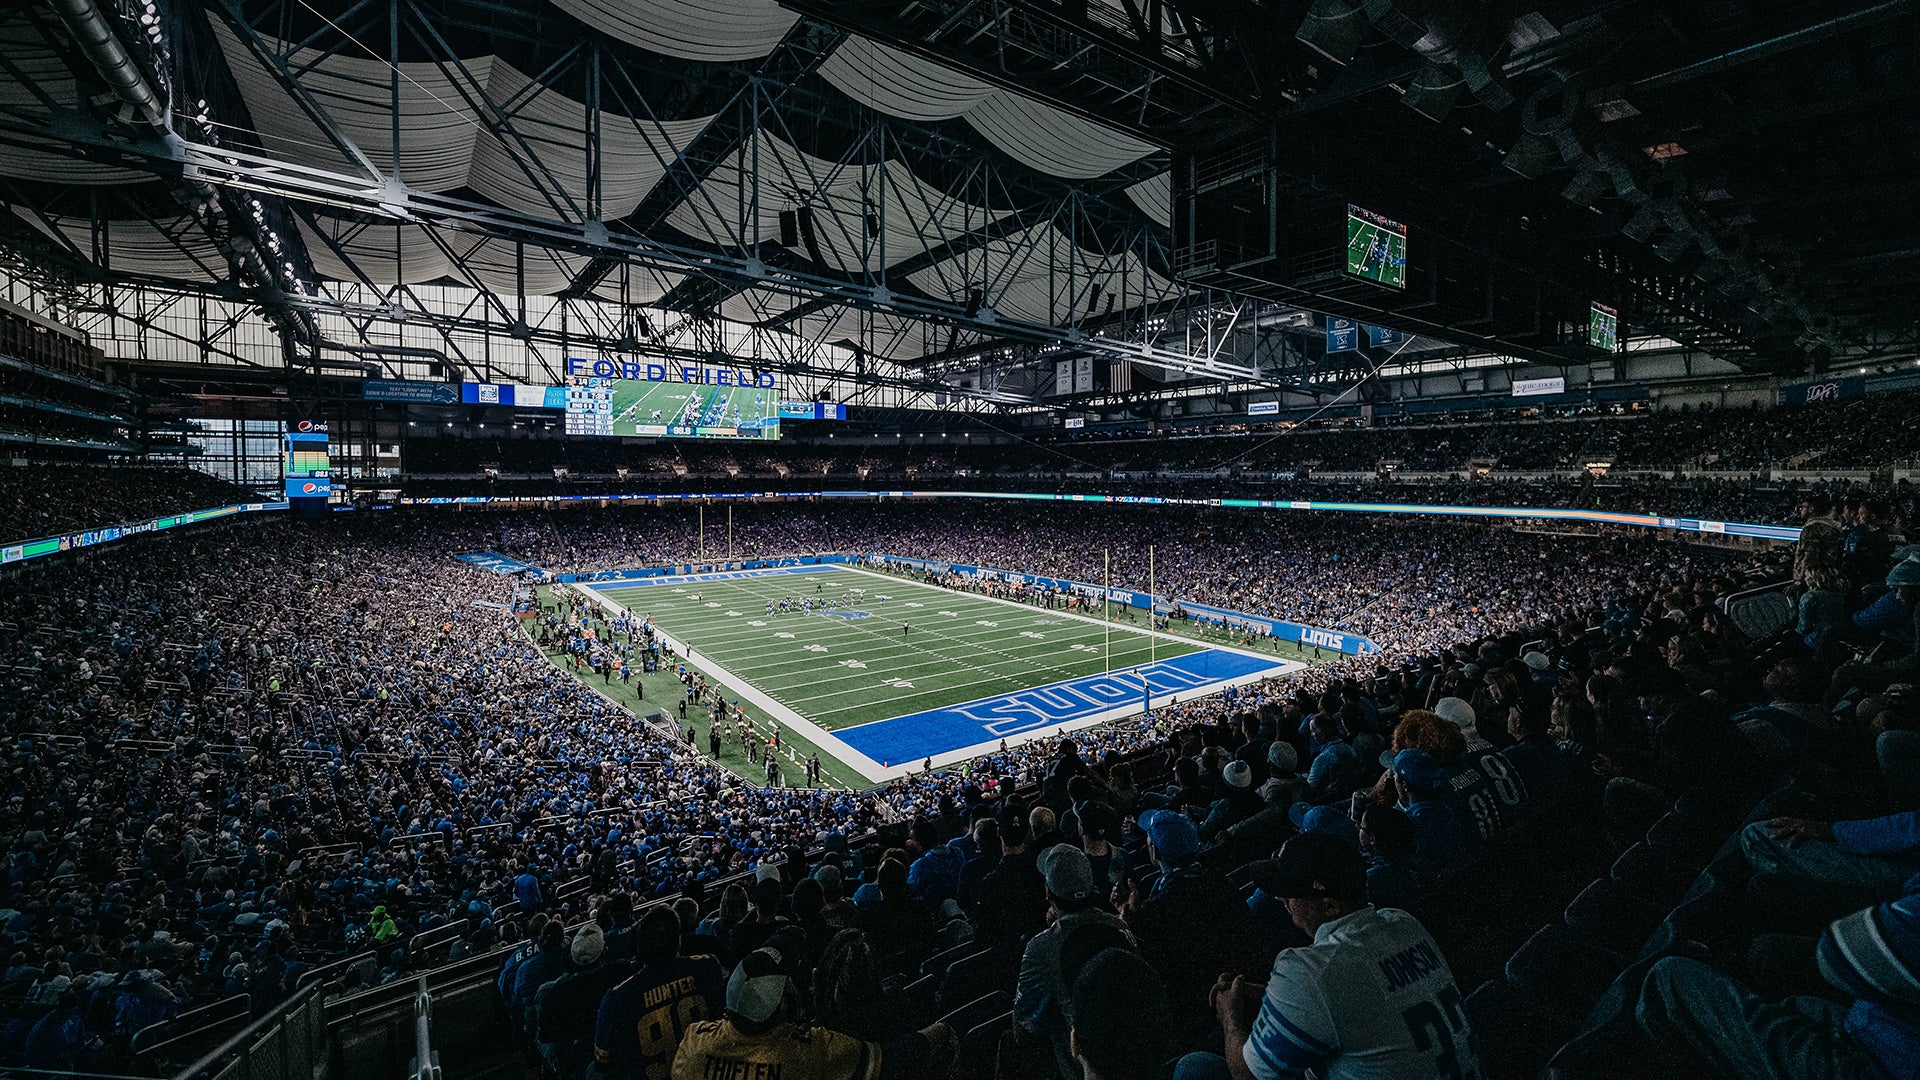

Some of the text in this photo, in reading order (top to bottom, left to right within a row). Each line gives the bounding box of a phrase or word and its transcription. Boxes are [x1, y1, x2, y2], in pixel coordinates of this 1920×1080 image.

[568, 358, 775, 389] FORD FIELD
[1107, 588, 1133, 604] LIONS
[1301, 627, 1344, 650] LIONS
[945, 662, 1222, 738] LIONS
[1378, 939, 1441, 992] JOHNSON
[641, 975, 697, 1009] HUNTER
